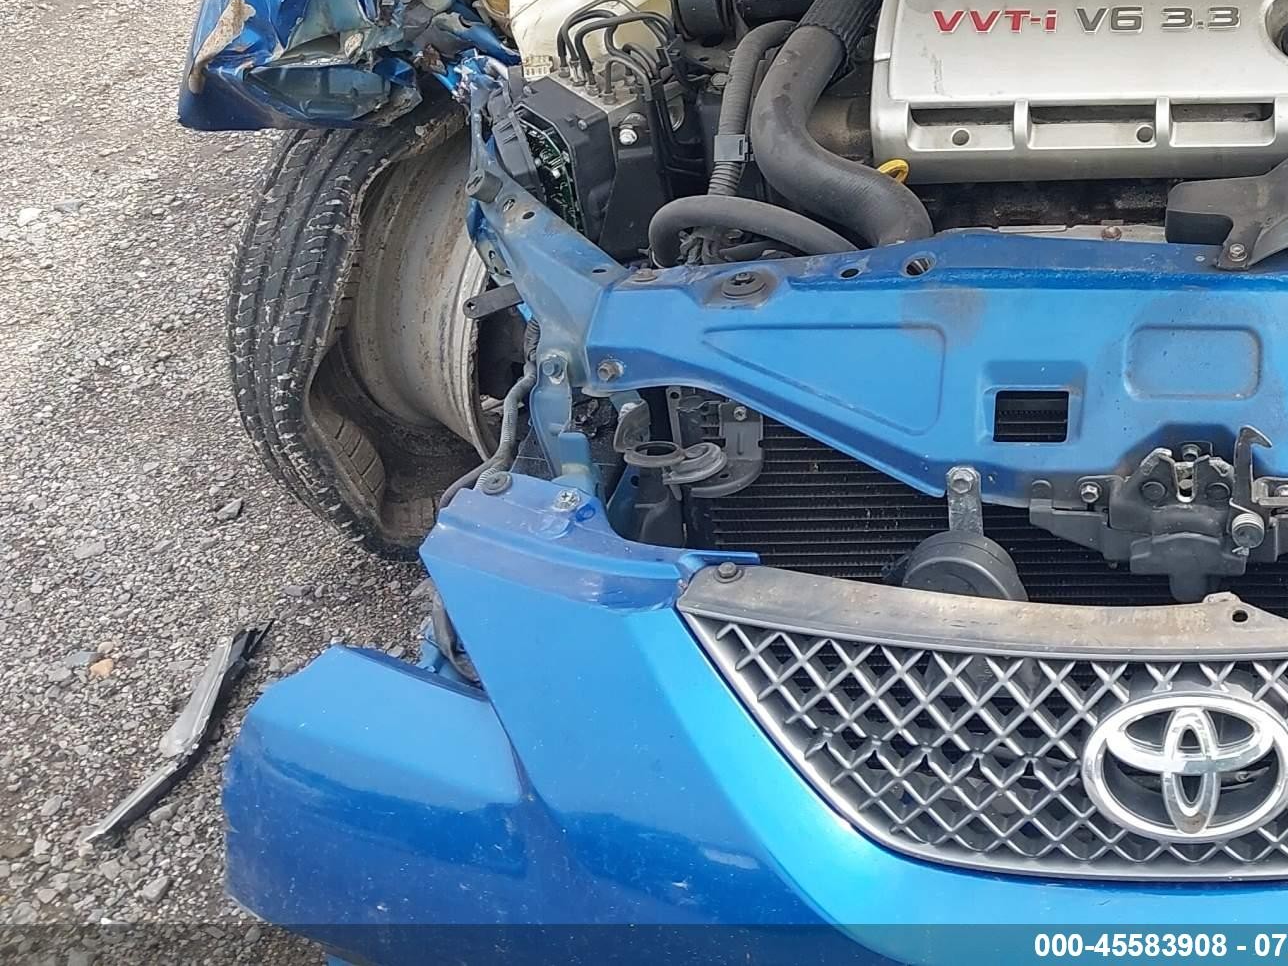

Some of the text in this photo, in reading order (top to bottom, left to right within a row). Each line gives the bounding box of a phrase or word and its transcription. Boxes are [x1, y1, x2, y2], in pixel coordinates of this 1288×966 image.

[932, 6, 1241, 34] VVT-i V6 3.3
